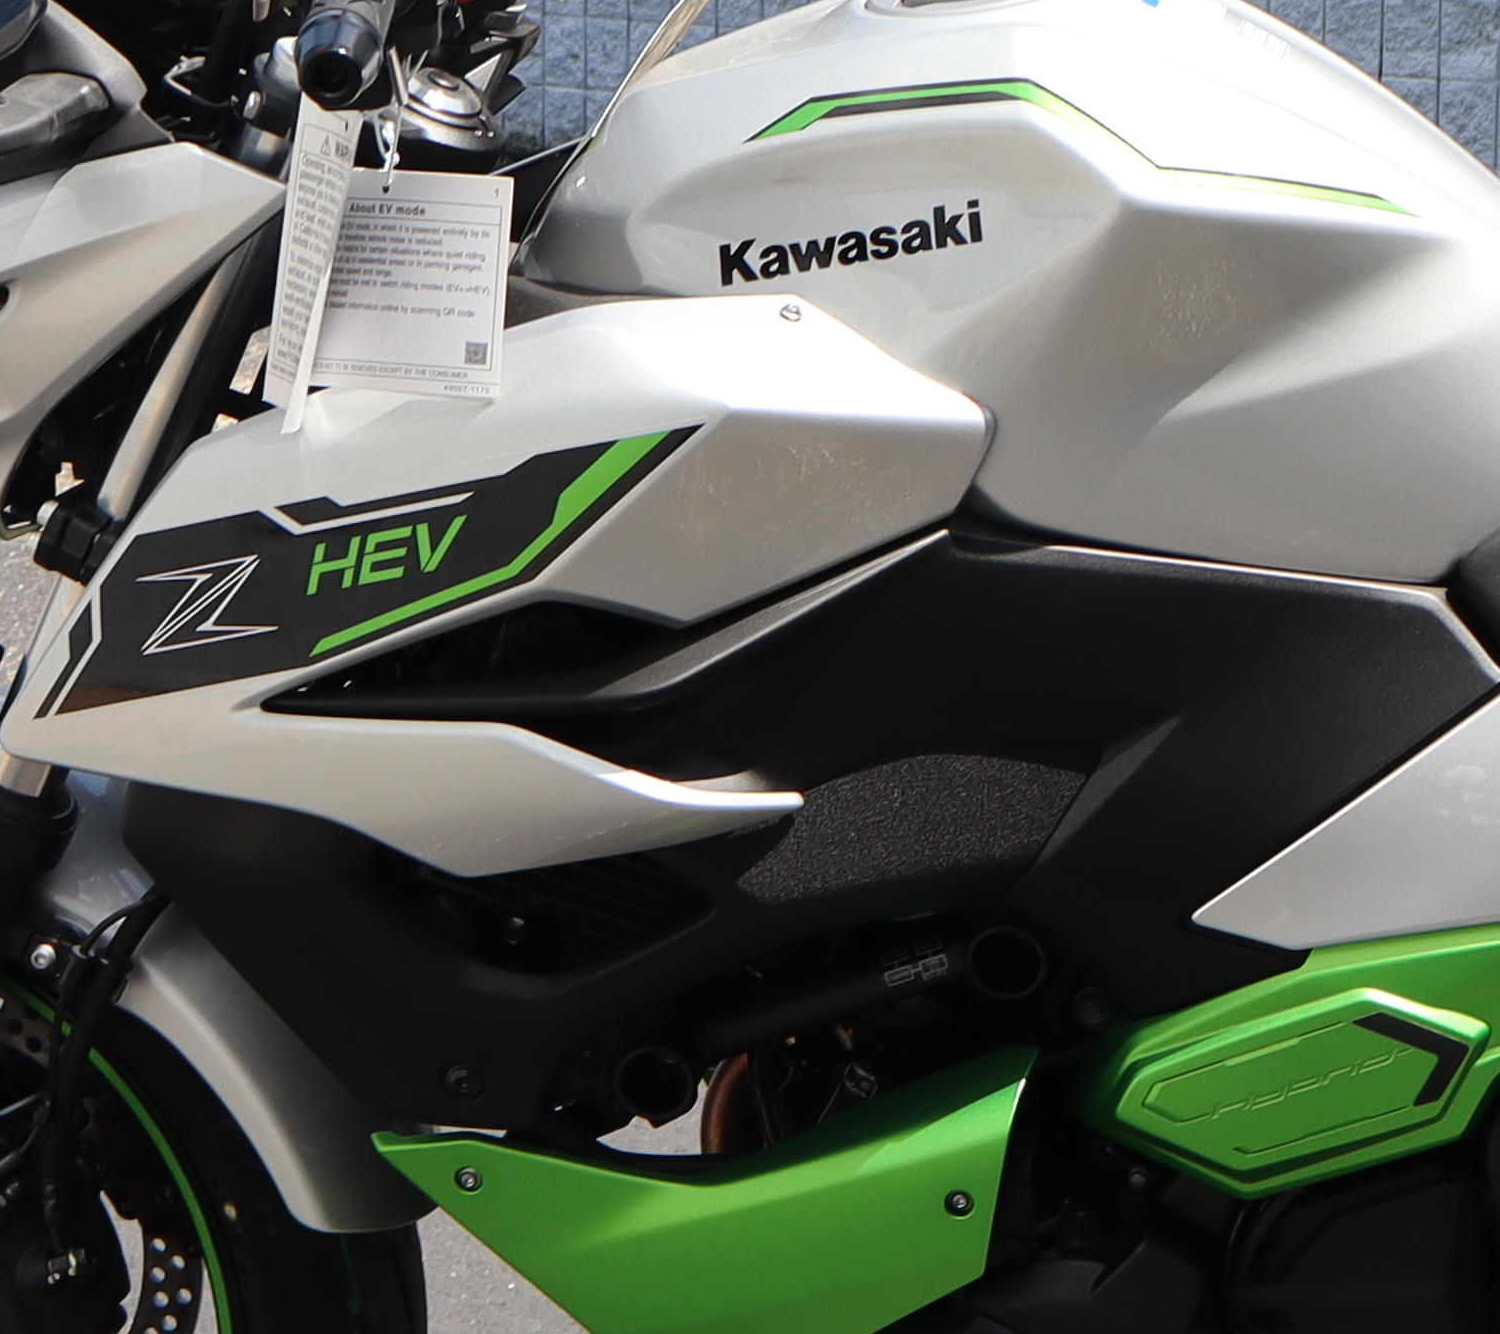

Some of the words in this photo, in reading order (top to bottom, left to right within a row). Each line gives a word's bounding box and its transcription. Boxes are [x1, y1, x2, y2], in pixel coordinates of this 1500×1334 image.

[349, 203, 376, 214] About
[378, 204, 393, 215] EV
[395, 205, 426, 216] mode
[719, 198, 983, 287] Kawasaki
[465, 251, 486, 262] riding
[443, 307, 455, 316] QR
[135, 554, 280, 657] Z
[306, 514, 468, 596] HEV
